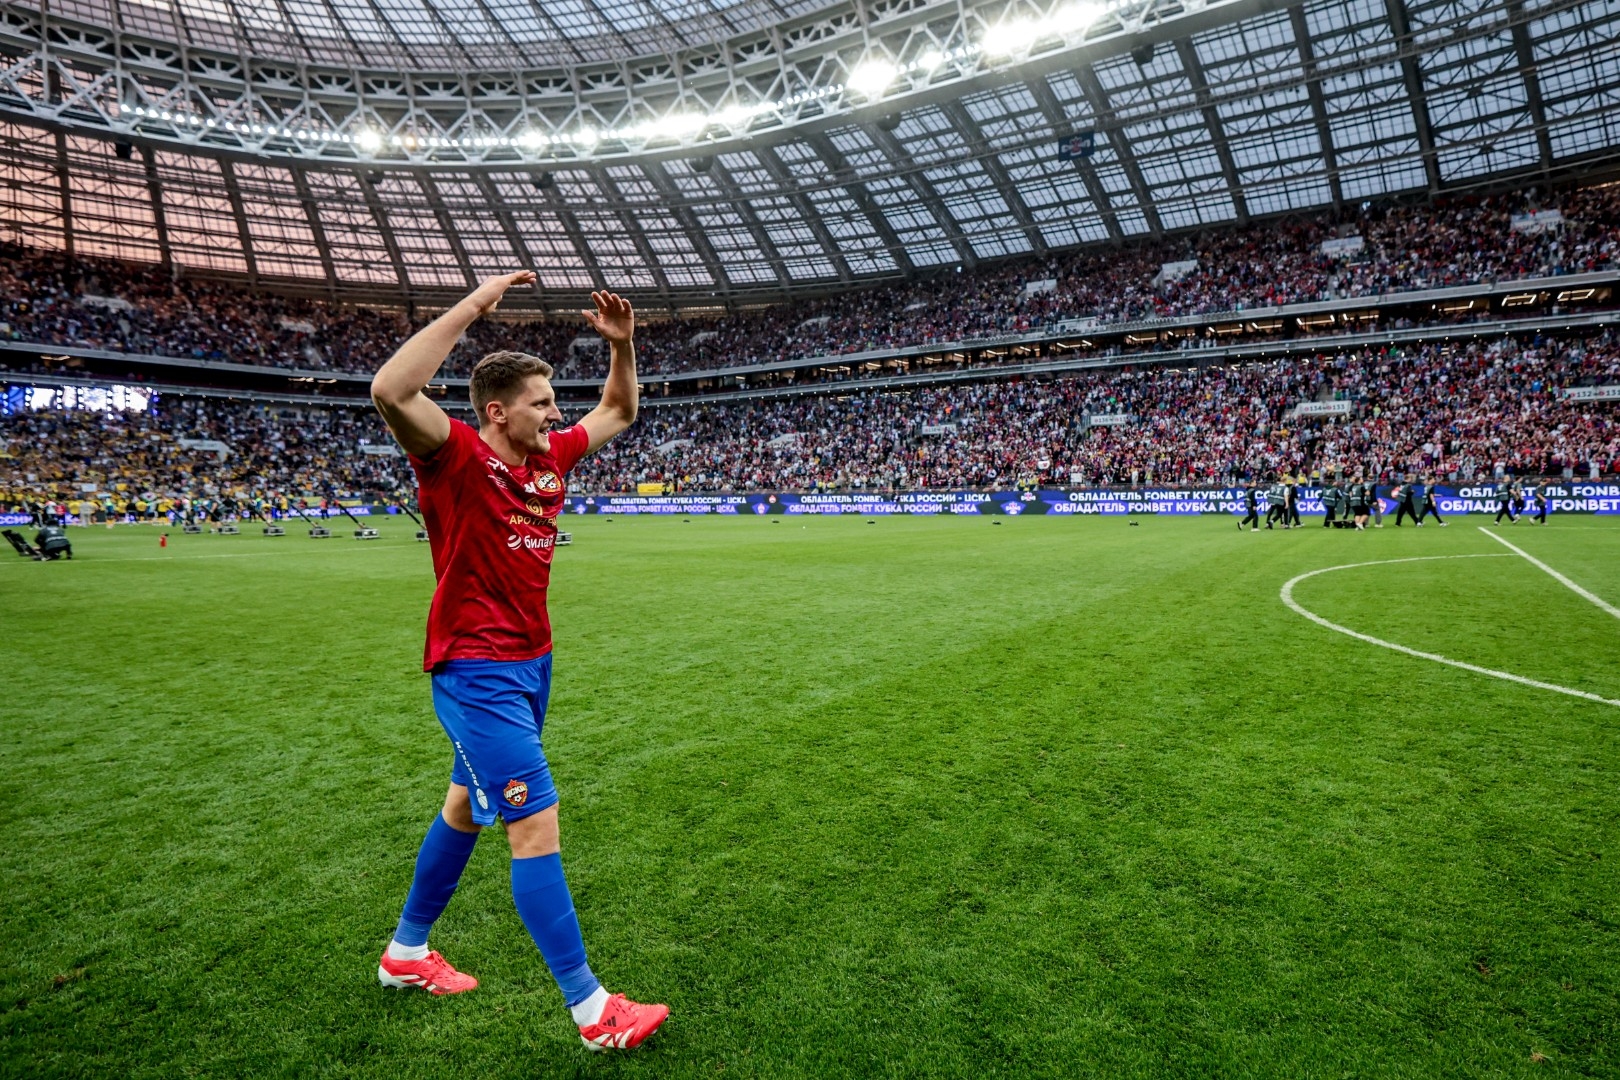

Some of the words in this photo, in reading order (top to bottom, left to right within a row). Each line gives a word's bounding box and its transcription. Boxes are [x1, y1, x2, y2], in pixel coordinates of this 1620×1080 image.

[917, 494, 955, 502] РОССИИ
[1070, 492, 1141, 501] ОБЛАДАТЕЛЬ
[1145, 492, 1190, 500] FONBET
[1193, 491, 1233, 499] КУБКА
[601, 505, 637, 513] ОБЛАДАТЕЛЬ
[717, 505, 735, 513] ЦСКА
[789, 504, 840, 513] ОБЛАДАТЕЛЬ
[841, 504, 873, 512] FONBET
[874, 504, 902, 512] КУБКА
[904, 504, 942, 512] РОССИИ
[951, 504, 977, 513] ЦСКА
[1054, 503, 1125, 513] ОБЛАДАТЕЛЬ
[1128, 502, 1173, 512] FONBET
[1176, 502, 1216, 512] КУБКА
[1552, 499, 1620, 510] FONBET
